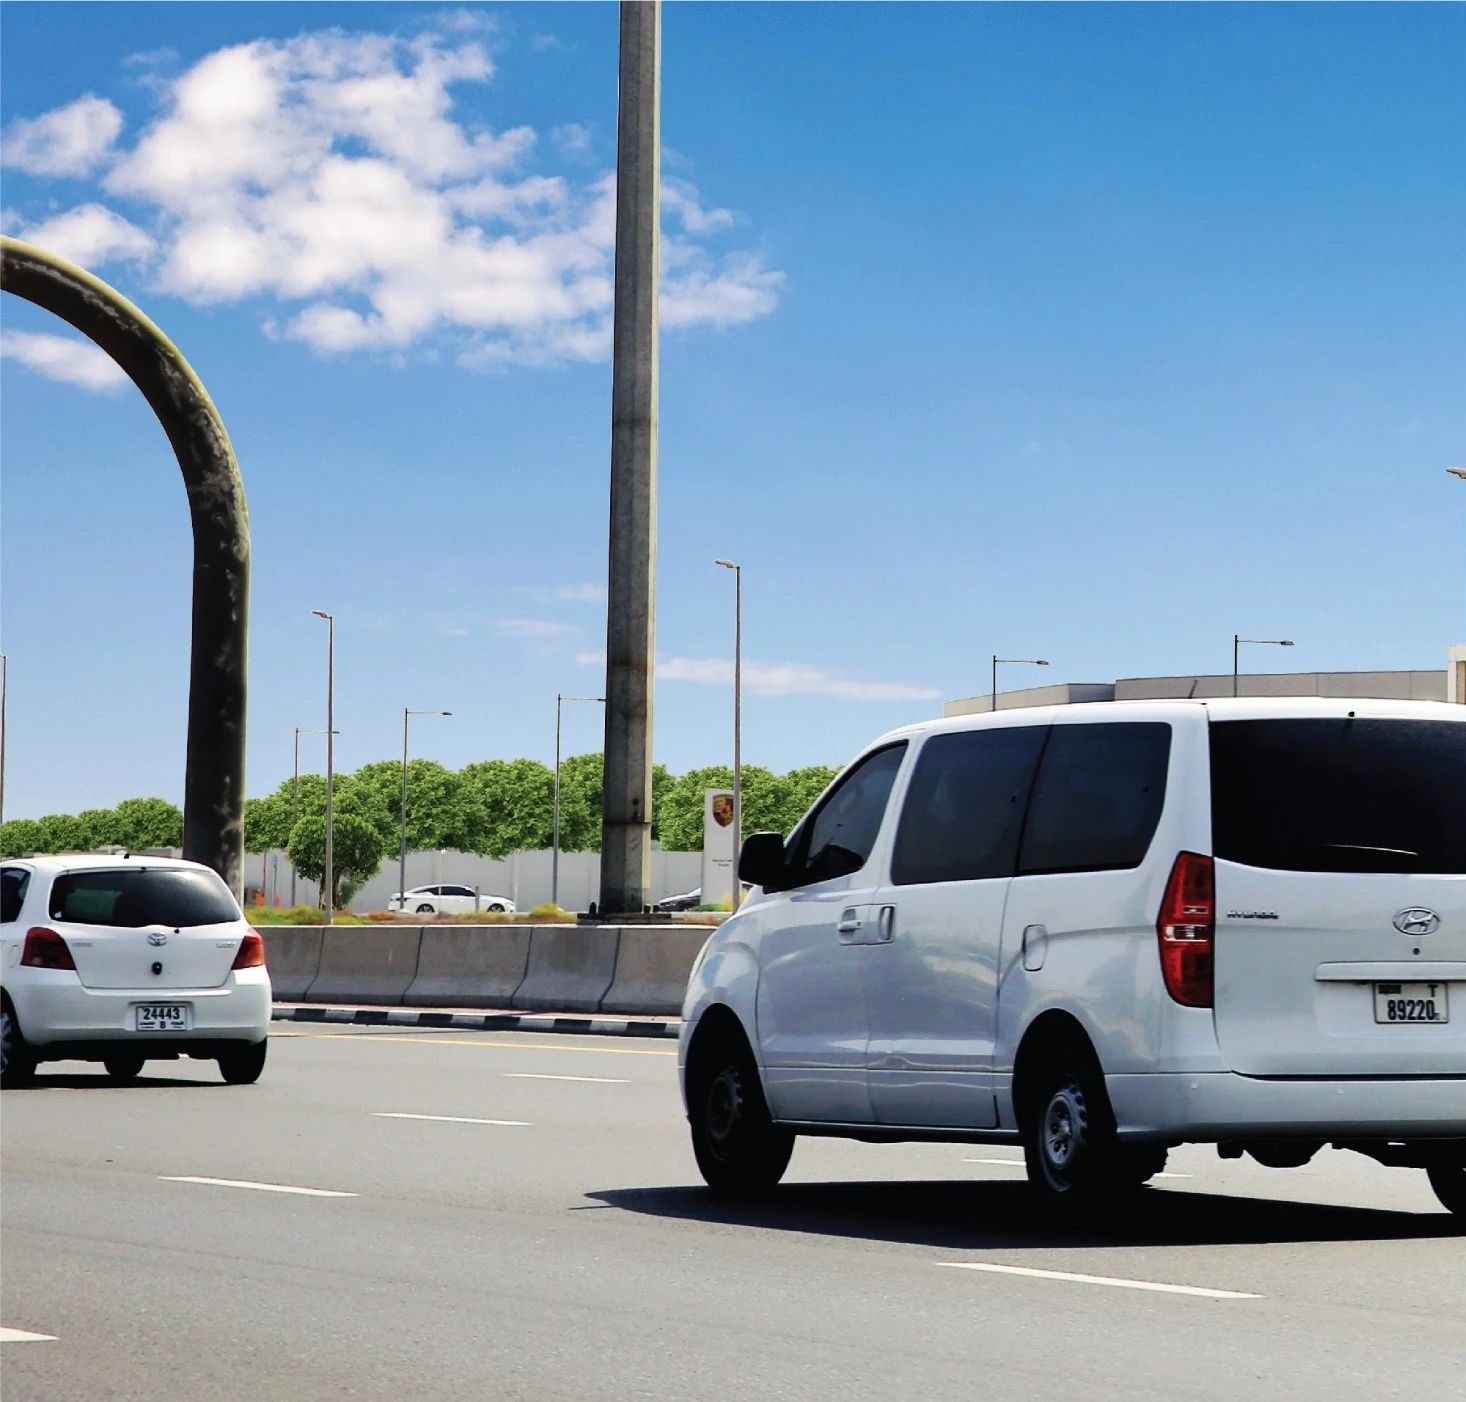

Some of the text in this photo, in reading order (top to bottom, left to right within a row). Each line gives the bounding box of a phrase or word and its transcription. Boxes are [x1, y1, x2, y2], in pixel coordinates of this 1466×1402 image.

[1427, 984, 1439, 998] T
[142, 1007, 180, 1020] 24443
[1387, 999, 1435, 1021] 89220
[159, 1020, 166, 1029] B
